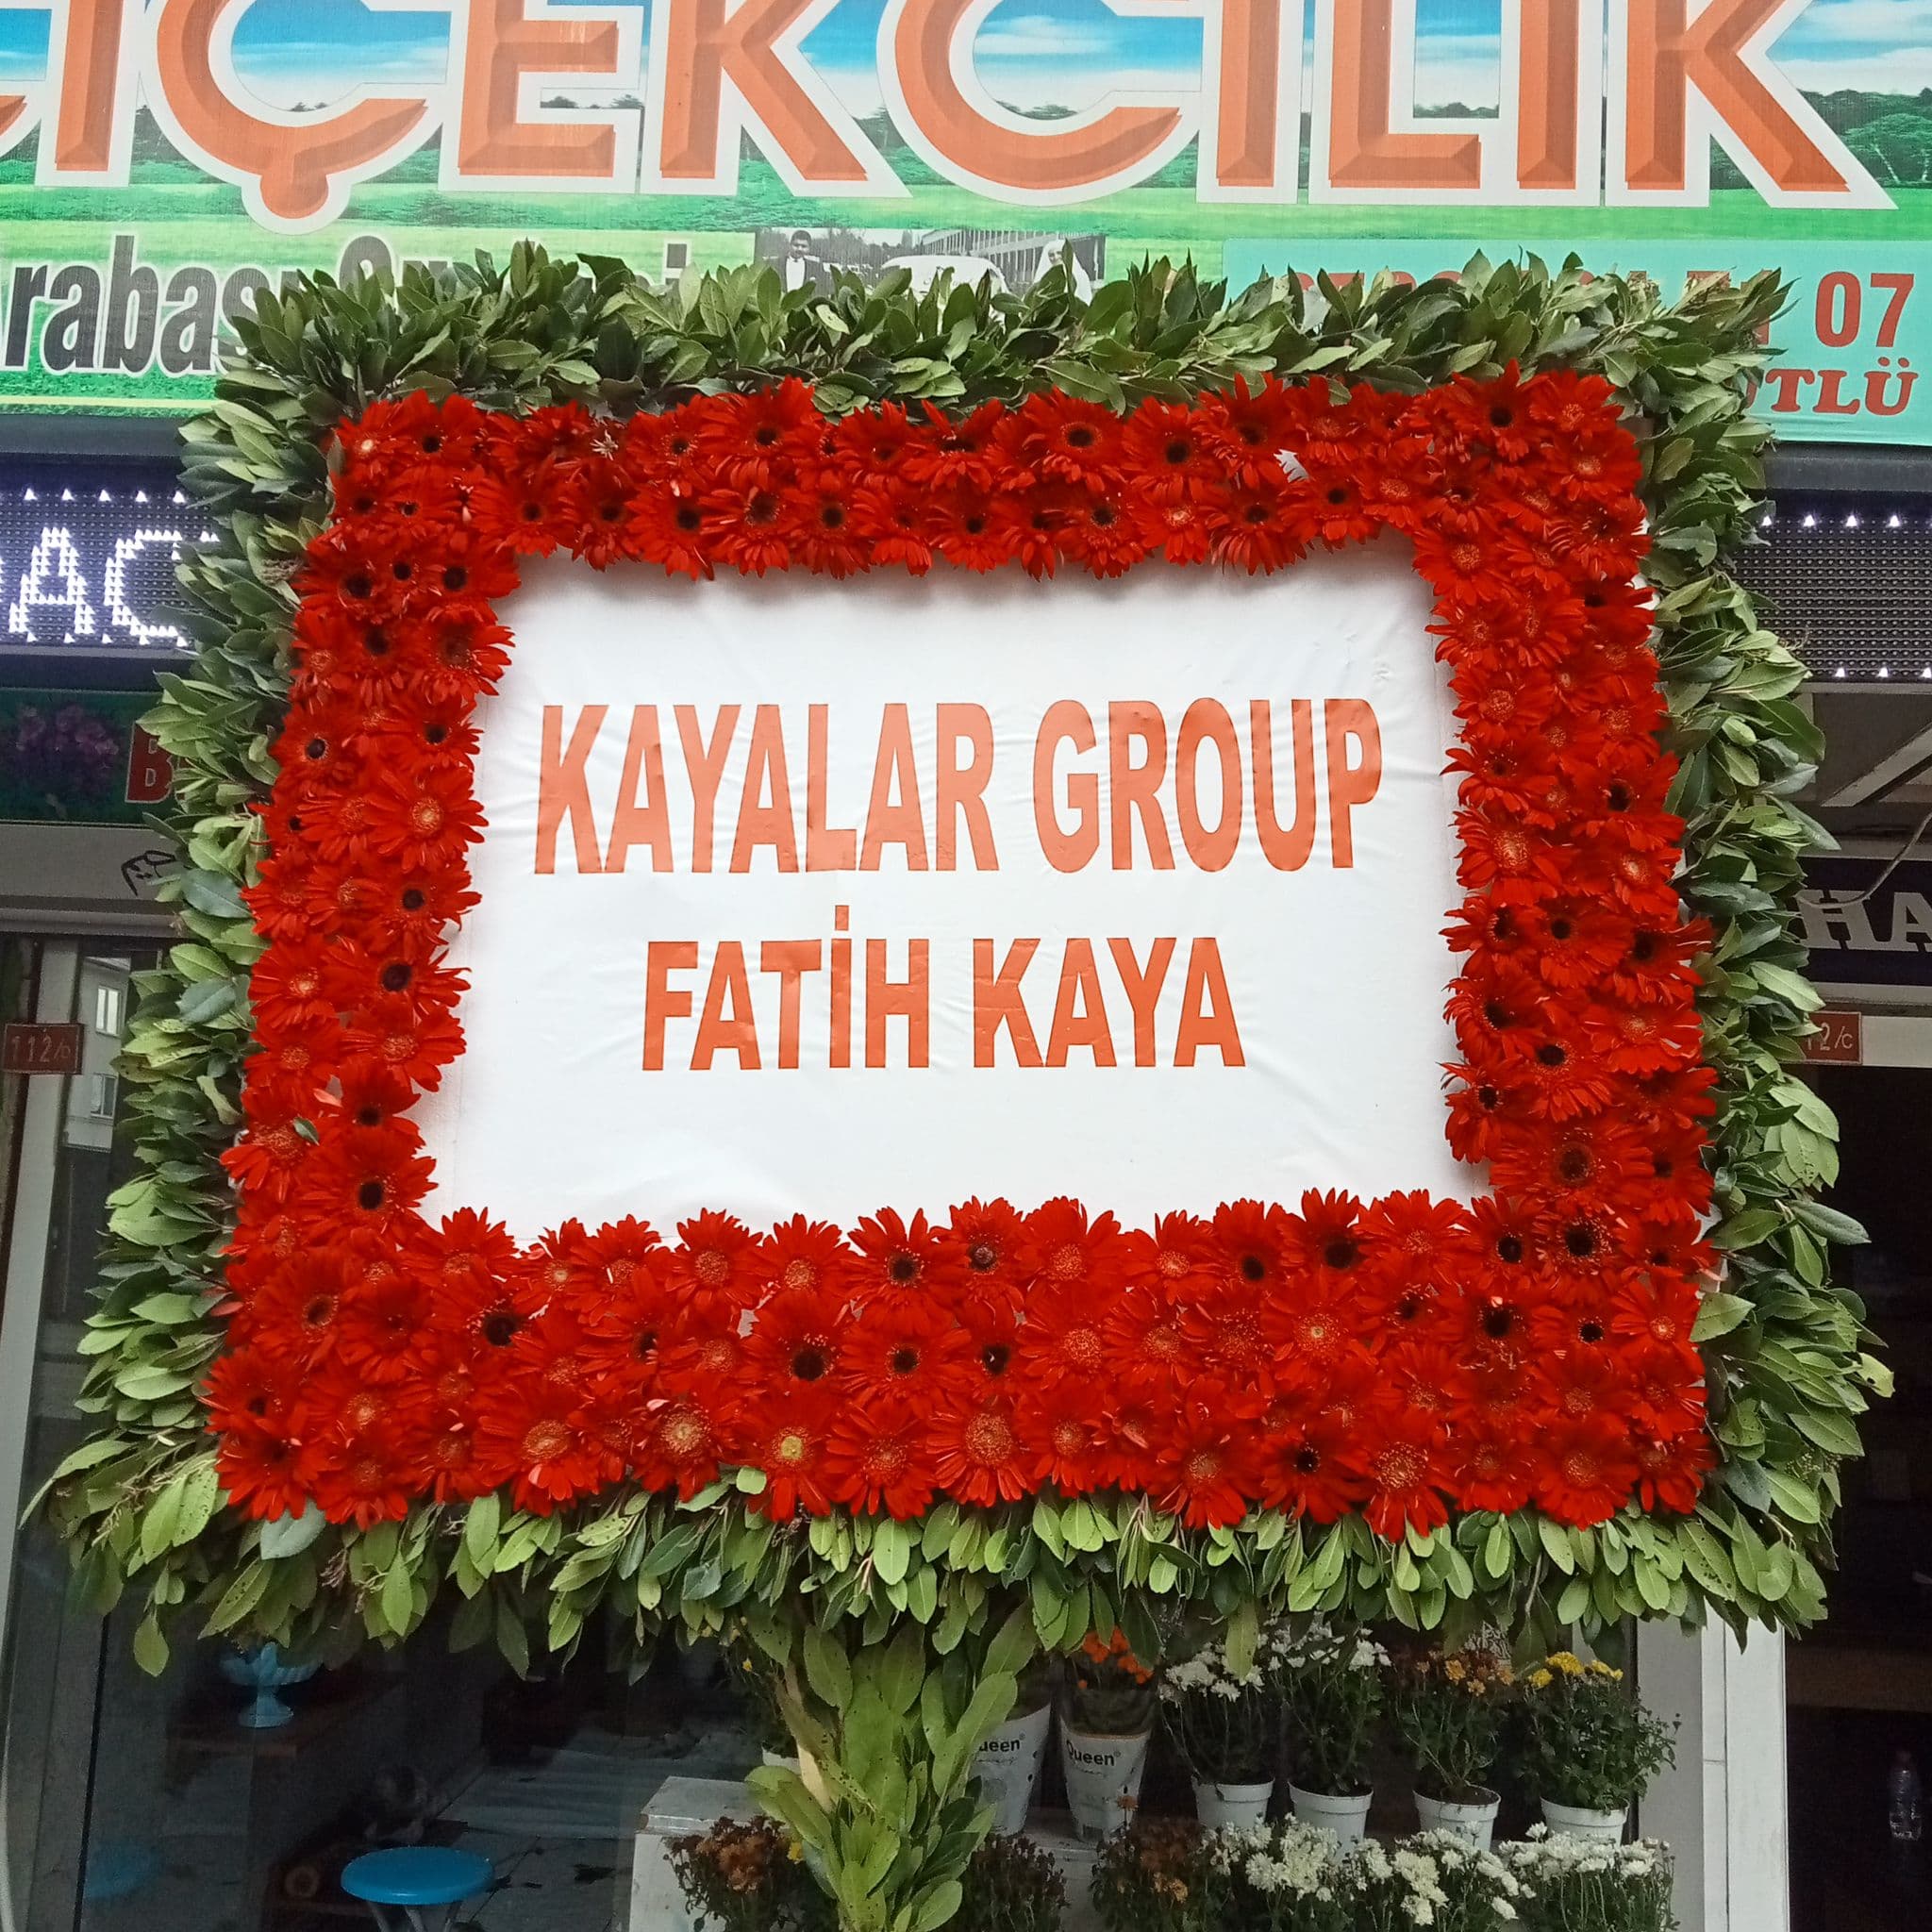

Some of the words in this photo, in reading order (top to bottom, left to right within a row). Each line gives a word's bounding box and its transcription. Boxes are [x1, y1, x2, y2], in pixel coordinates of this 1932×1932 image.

[5, 234, 304, 374] rabas
[534, 703, 1000, 874] KAYALAR
[1033, 697, 1383, 873] GROUP
[642, 905, 930, 1071] FATİH
[973, 937, 1246, 1068] KAYA
[1066, 1740, 1116, 1767] Queen
